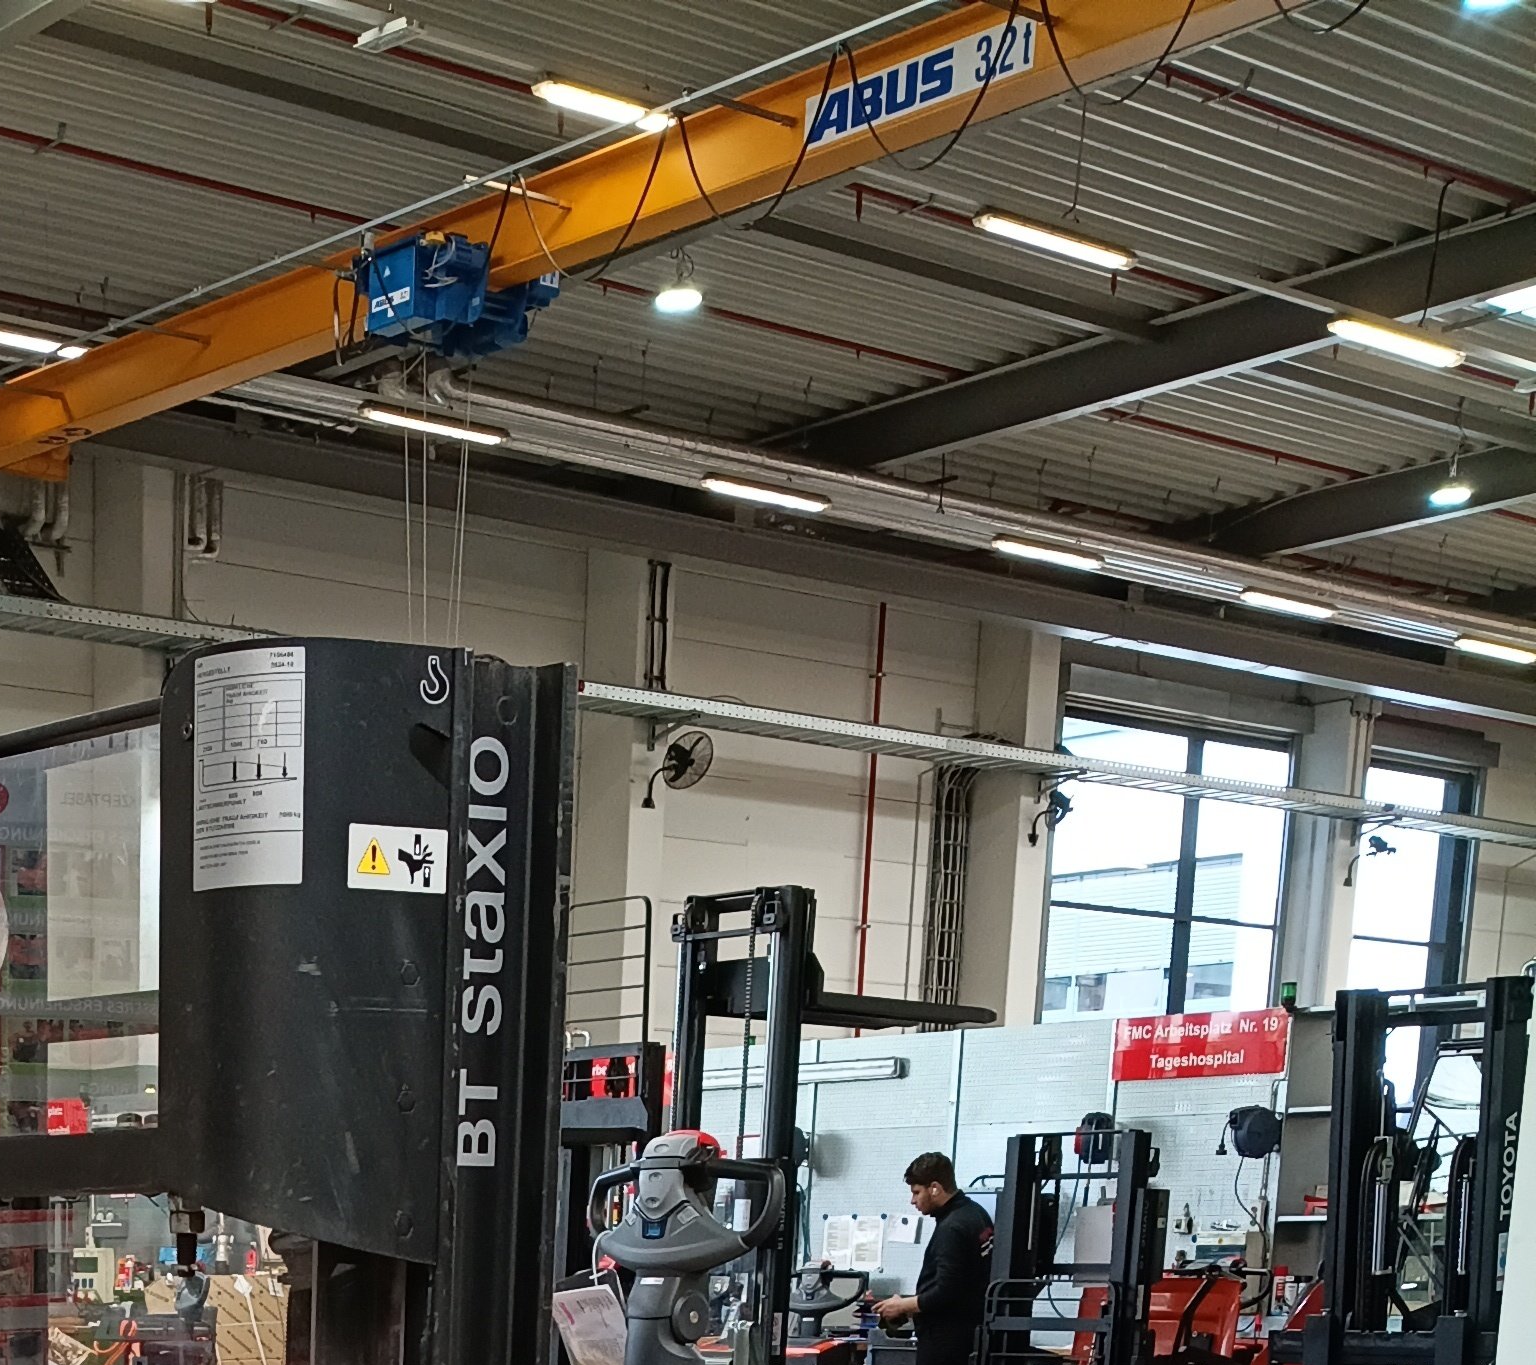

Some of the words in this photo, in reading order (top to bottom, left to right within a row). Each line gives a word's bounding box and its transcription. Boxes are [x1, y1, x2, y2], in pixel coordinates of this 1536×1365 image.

[808, 47, 955, 145] ABUS
[1123, 1025, 1152, 1040] FMC
[1155, 1021, 1233, 1039] Arbeitsplatz
[1239, 1018, 1258, 1033] Nr.
[1263, 1016, 1279, 1032] 19
[1150, 1049, 1244, 1070] Tageshospital
[456, 1068, 499, 1167] BT
[1499, 1111, 1519, 1221] TOYOTA
